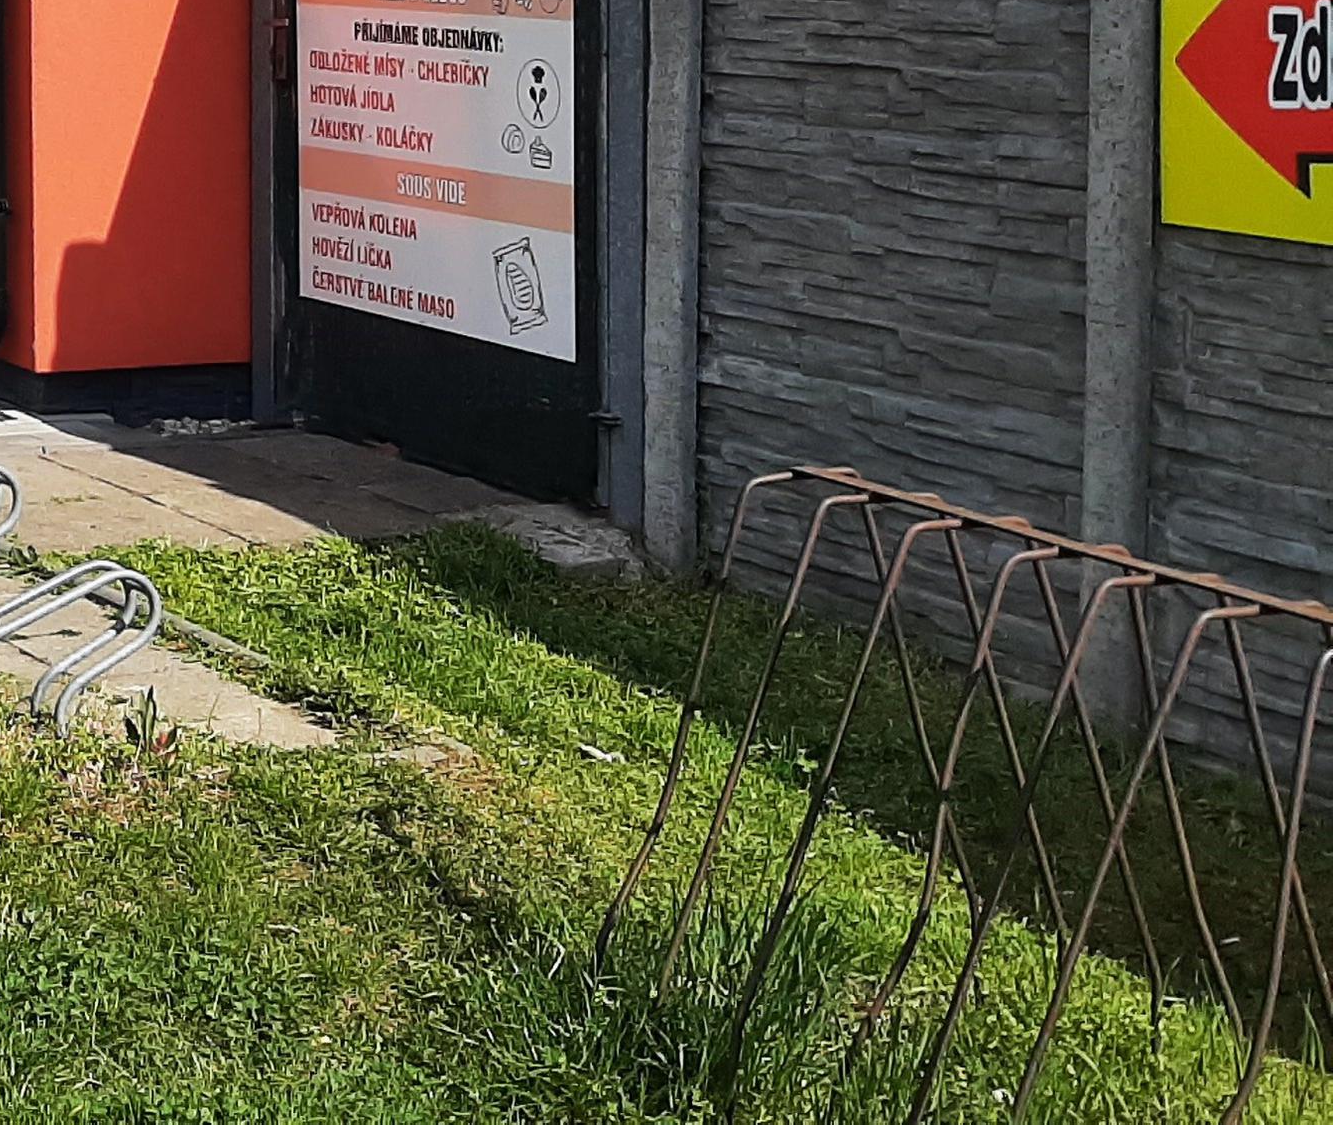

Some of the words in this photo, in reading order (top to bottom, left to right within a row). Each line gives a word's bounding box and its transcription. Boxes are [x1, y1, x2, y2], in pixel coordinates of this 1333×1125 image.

[310, 49, 371, 75] OBLOŽENÉ
[374, 52, 405, 79] MÍSY
[310, 84, 357, 108] HOTOVÁ
[360, 85, 395, 112] JÍDLA
[310, 116, 364, 143] ZÁKUSKY
[376, 125, 433, 153] KOLÁČKY
[397, 173, 432, 200] SOUS
[435, 178, 467, 205] VIDE
[311, 201, 366, 231] VEPŘOVÁ
[369, 213, 418, 240] KOLENA
[312, 236, 354, 262] HOVĚZÍ
[312, 266, 363, 299] ČERSTVÉ
[367, 280, 414, 310] BALENÉ
[417, 291, 455, 320] MASO
